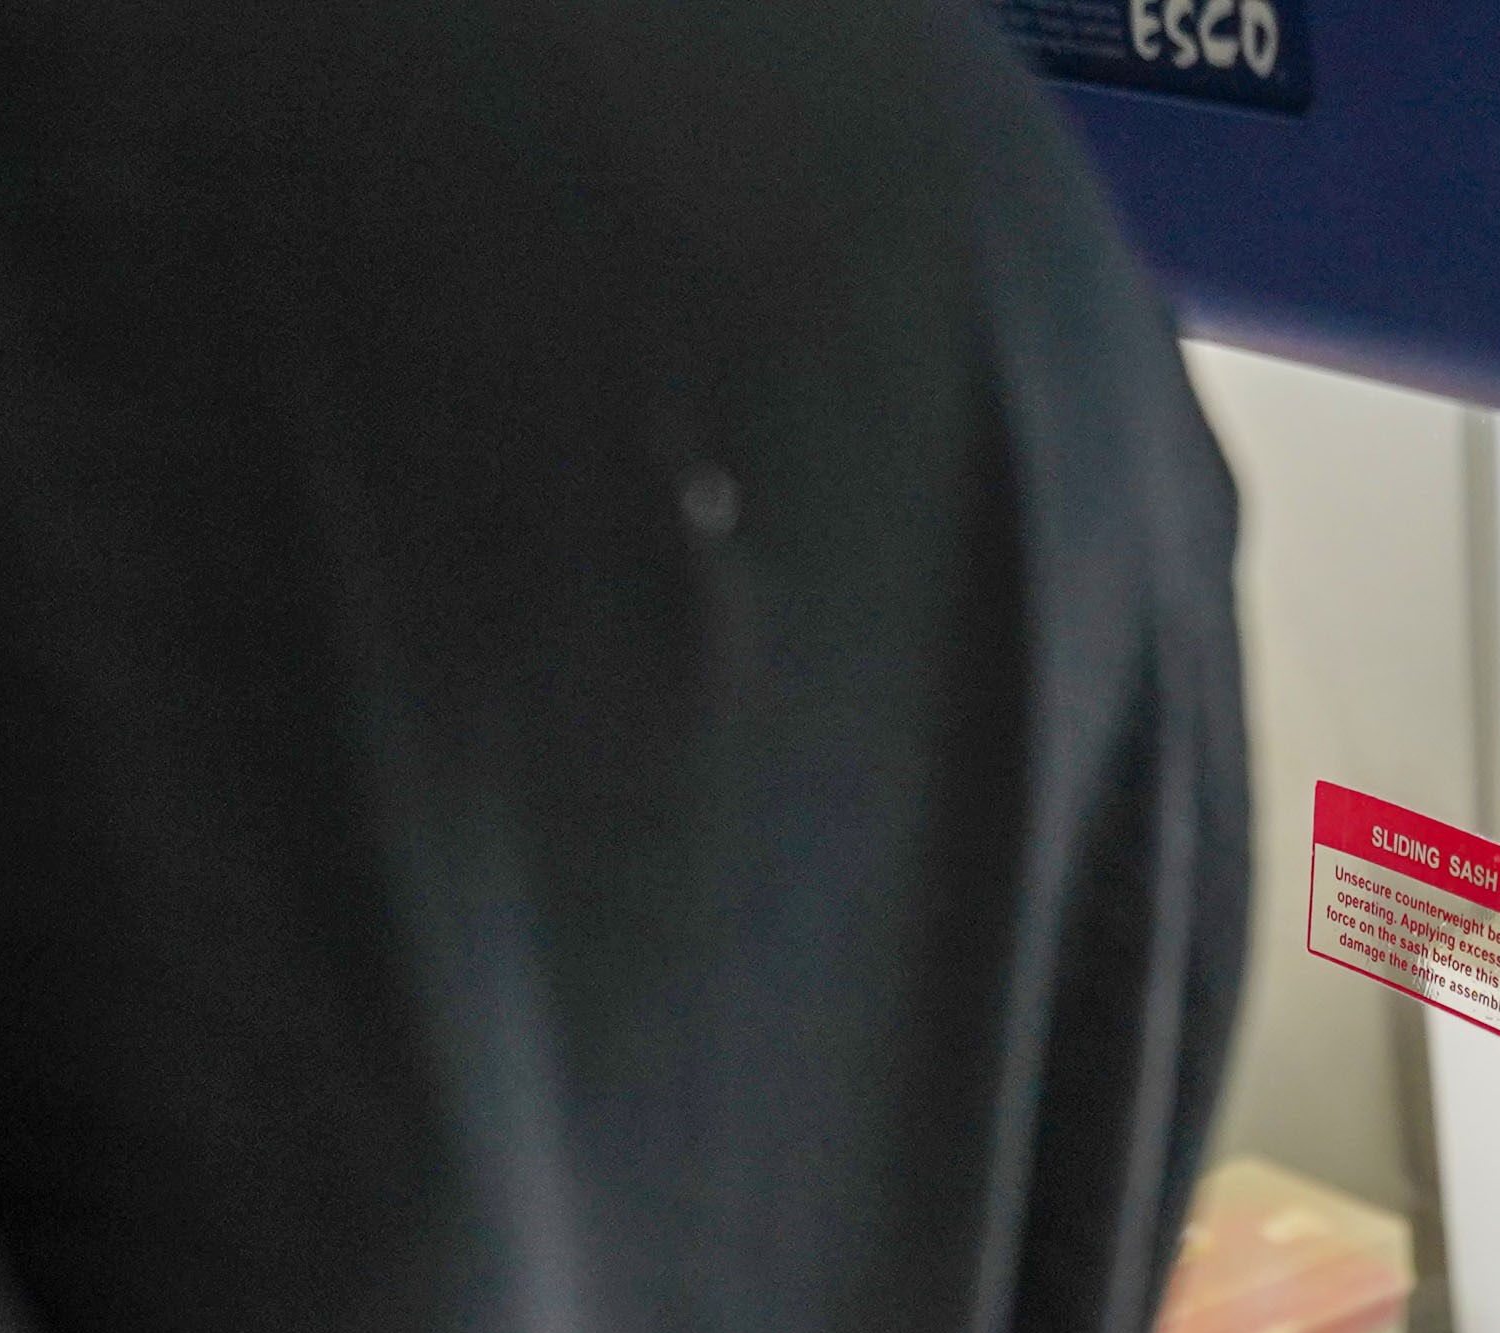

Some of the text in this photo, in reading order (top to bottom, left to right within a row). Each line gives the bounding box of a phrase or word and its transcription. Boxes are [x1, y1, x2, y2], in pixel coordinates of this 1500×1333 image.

[1130, 0, 1279, 78] ESCO
[1372, 825, 1499, 892] SLIDING SASH
[1335, 865, 1391, 899] Unsecure
[1395, 892, 1485, 936] counterweight
[1337, 892, 1398, 924] operating.
[1401, 913, 1455, 950] Applying
[1327, 907, 1356, 928] force
[1359, 921, 1375, 937] on
[1378, 925, 1397, 946] the
[1400, 935, 1430, 958] sash
[1433, 949, 1473, 977] before
[1476, 968, 1499, 988] this
[1339, 934, 1386, 962] damage
[1389, 951, 1408, 971] the
[1411, 963, 1446, 988] entire
